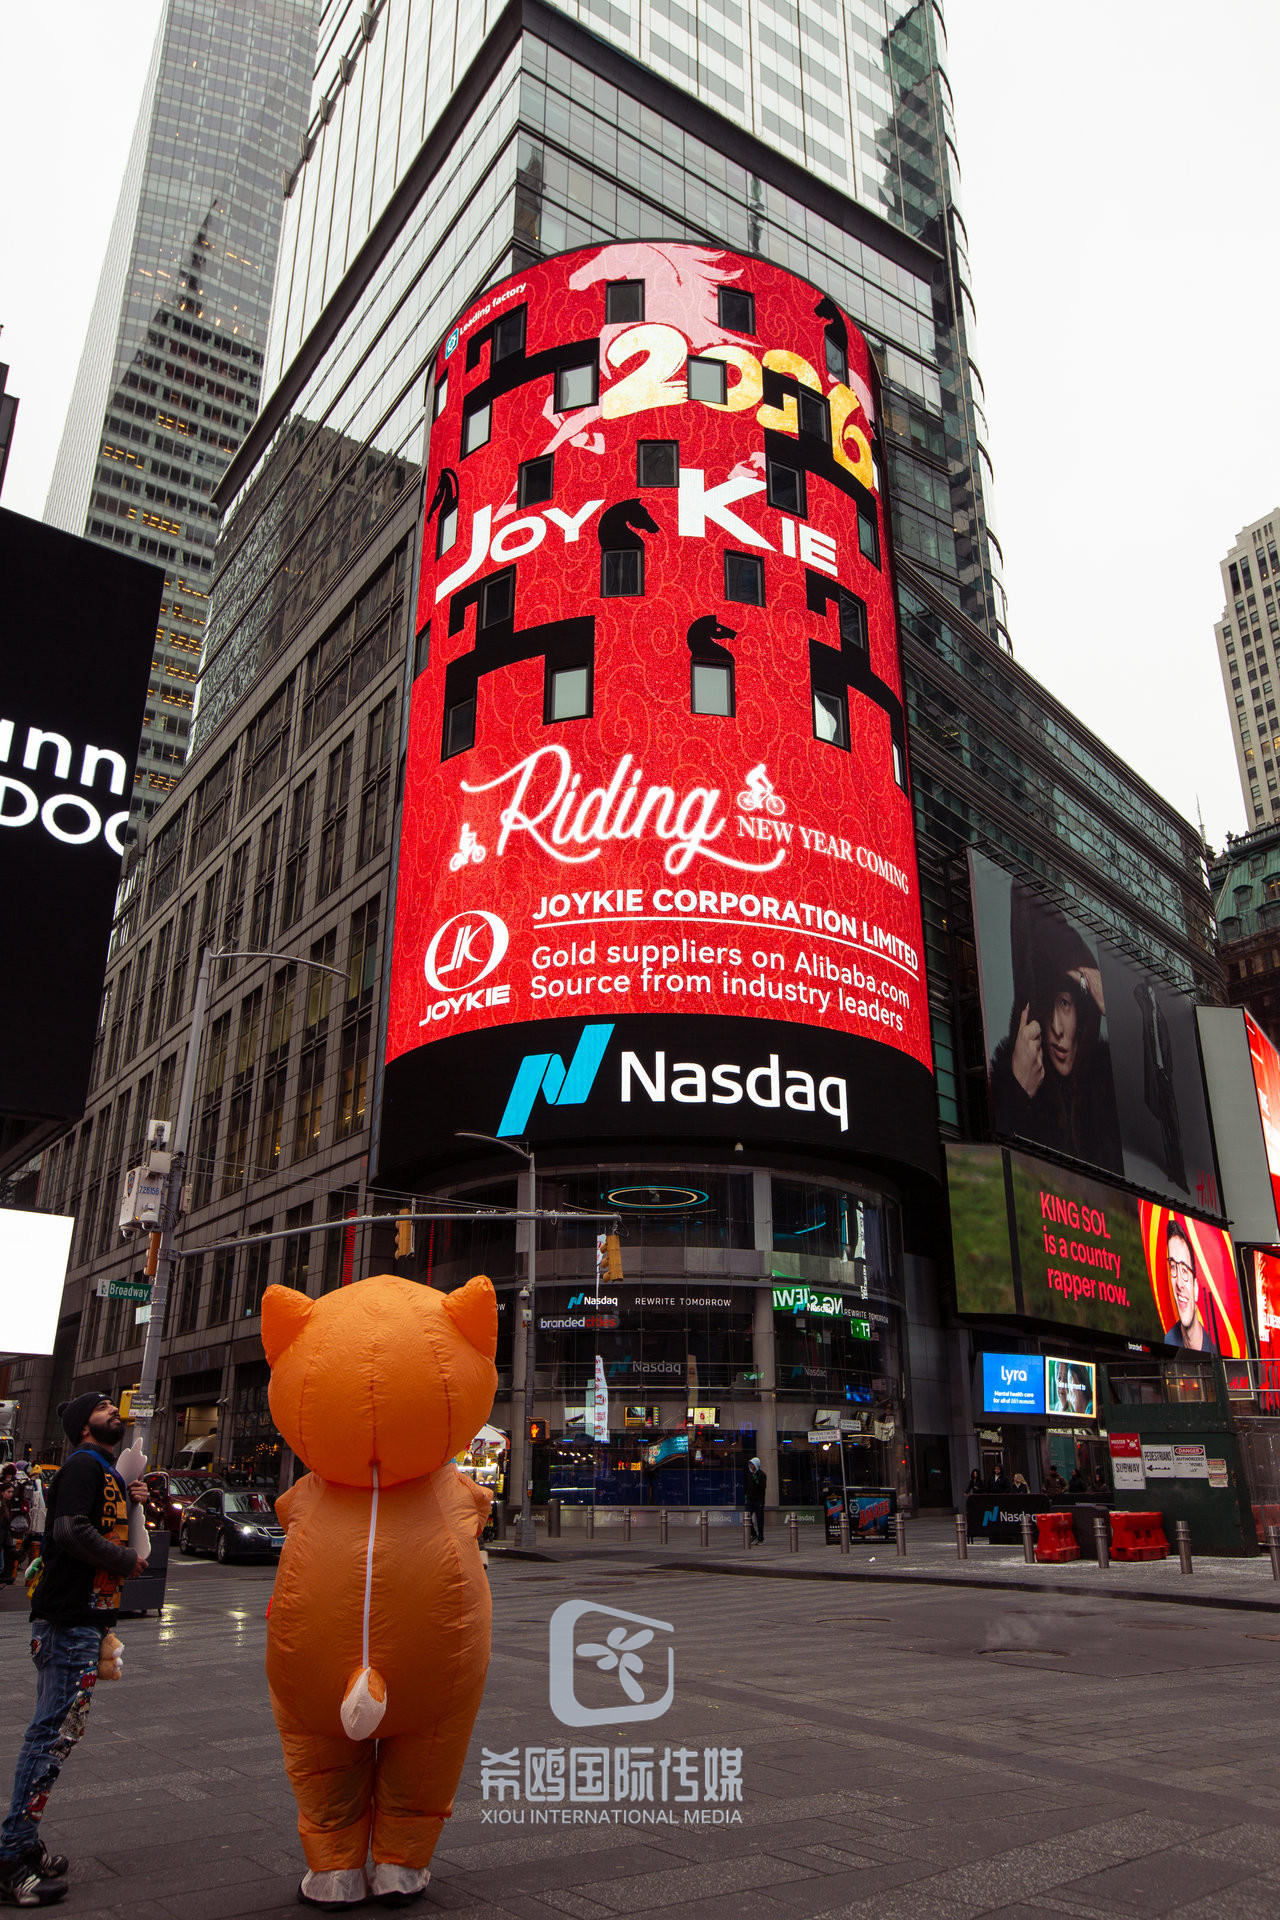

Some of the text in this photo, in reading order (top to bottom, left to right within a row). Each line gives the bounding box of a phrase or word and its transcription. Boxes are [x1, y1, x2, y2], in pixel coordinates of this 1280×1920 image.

[460, 282, 527, 336] Leading factory
[602, 321, 875, 490] 2026
[460, 743, 786, 876] Riding
[737, 815, 909, 895] NEW YEAR COMING
[532, 889, 919, 972] JOYKIE CORPORATION LIMITED
[532, 939, 910, 1010] Gold suppliers on Alibaba.com
[418, 984, 511, 1027] JOYKIE
[530, 967, 904, 1032] Source from industry leaders
[621, 1050, 849, 1132] Nasdaq
[1040, 1191, 1112, 1239] KING SOL
[1043, 1225, 1121, 1279] is a country
[109, 1283, 149, 1300] Broadway
[584, 1296, 732, 1307] Nasdaq REWRITE TOMORROW
[1047, 1268, 1130, 1307] rapper now.
[632, 1360, 682, 1376] Nasdaq
[1001, 1365, 1028, 1385] lyra
[1115, 1462, 1140, 1473] SUBWAY
[1144, 1450, 1172, 1462] PEDESTRIANS
[858, 1499, 891, 1529] AMAZE
